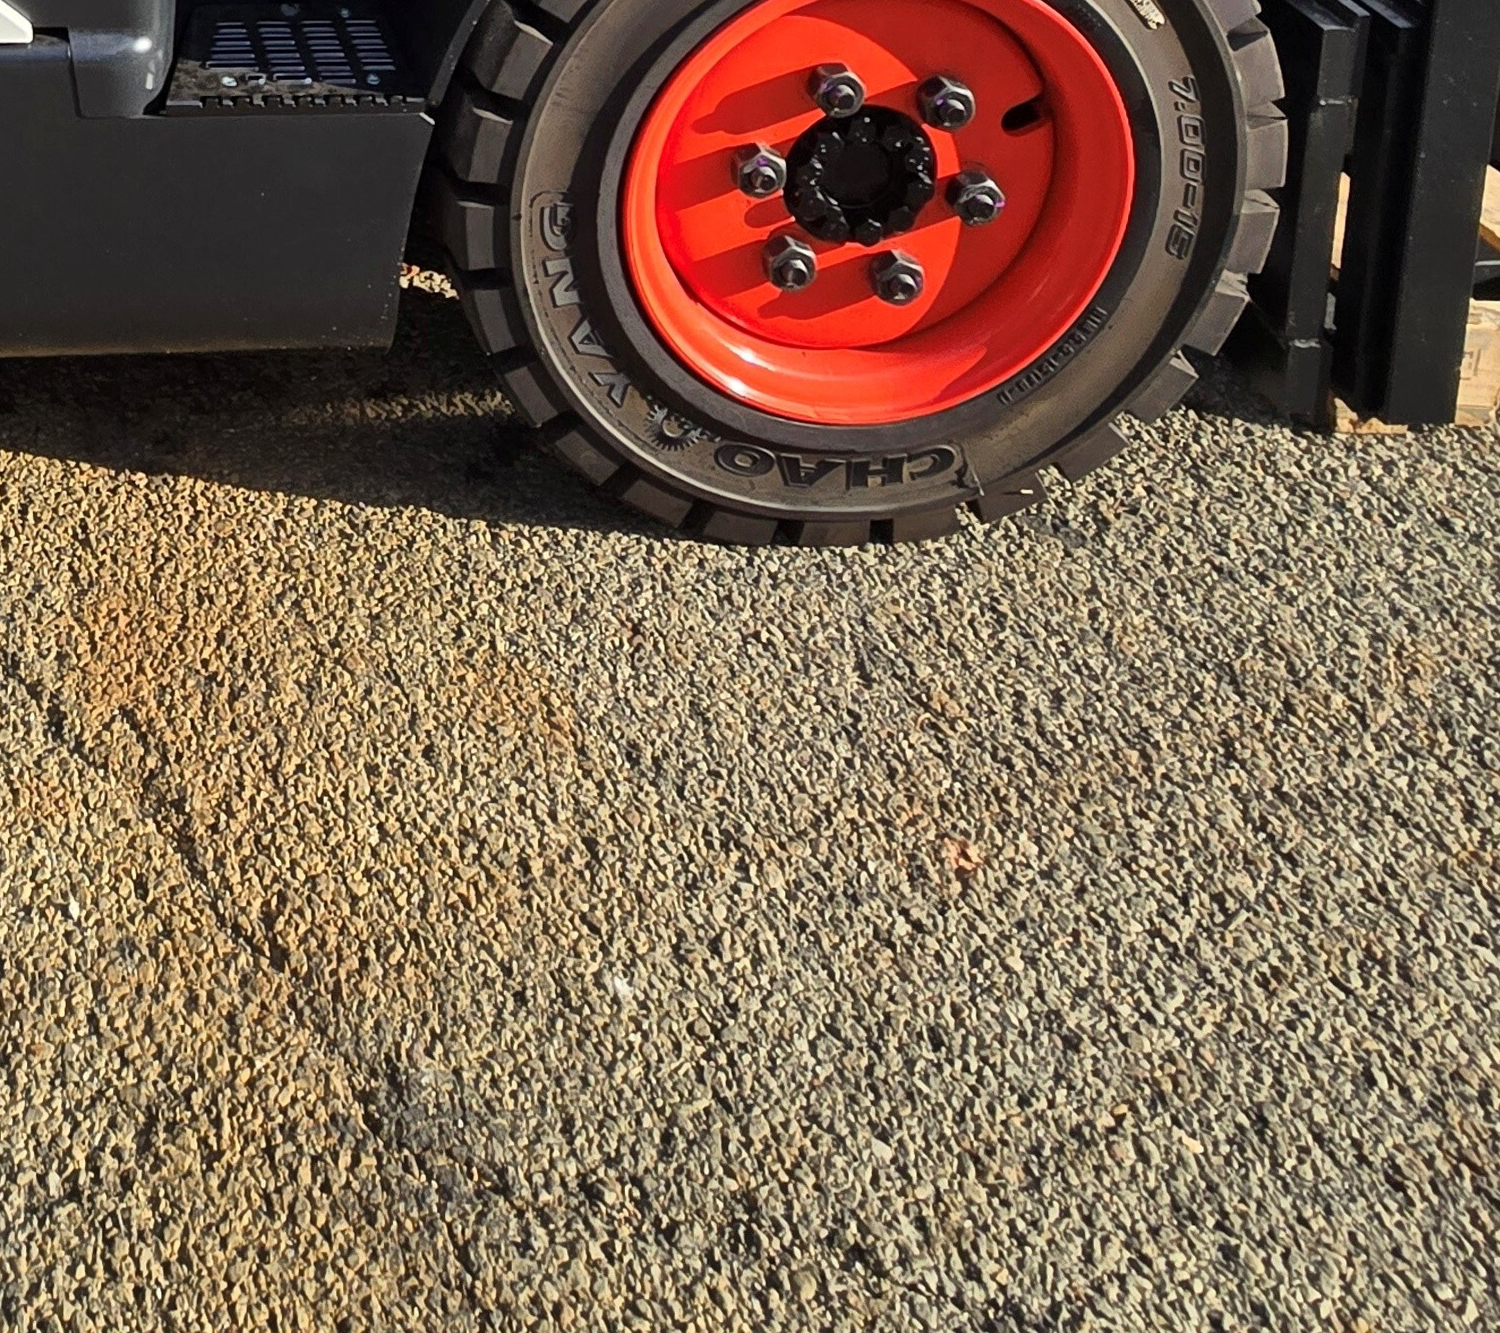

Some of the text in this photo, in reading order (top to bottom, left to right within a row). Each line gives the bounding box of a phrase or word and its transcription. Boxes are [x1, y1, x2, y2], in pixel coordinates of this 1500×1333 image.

[1164, 75, 1206, 261] 7.00-15
[540, 201, 633, 409] YANG
[712, 442, 956, 490] CHAO
